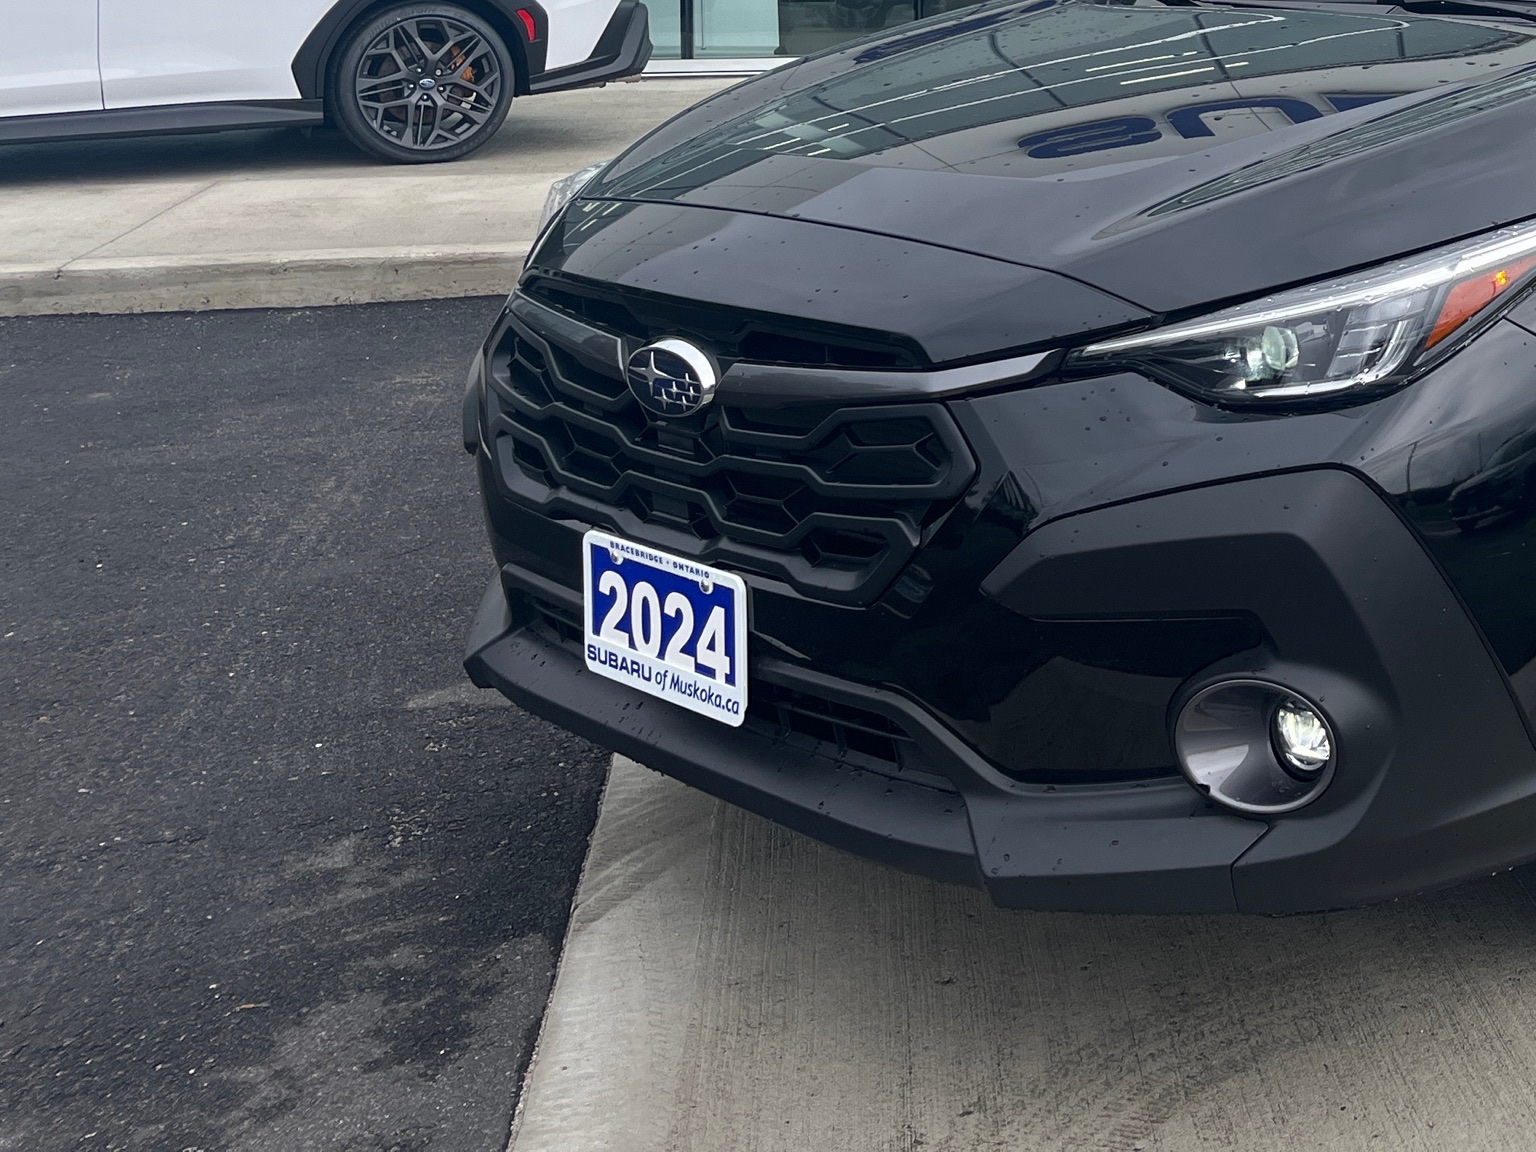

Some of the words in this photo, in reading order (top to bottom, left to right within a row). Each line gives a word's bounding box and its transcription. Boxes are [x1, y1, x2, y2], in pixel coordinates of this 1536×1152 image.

[610, 540, 664, 565] BRACEBRIDGE
[672, 561, 710, 579] ONTARIO
[598, 570, 730, 684] 2024
[587, 643, 652, 682] SUBARU
[655, 669, 668, 692] of
[669, 674, 740, 715] Muskoka.ca
